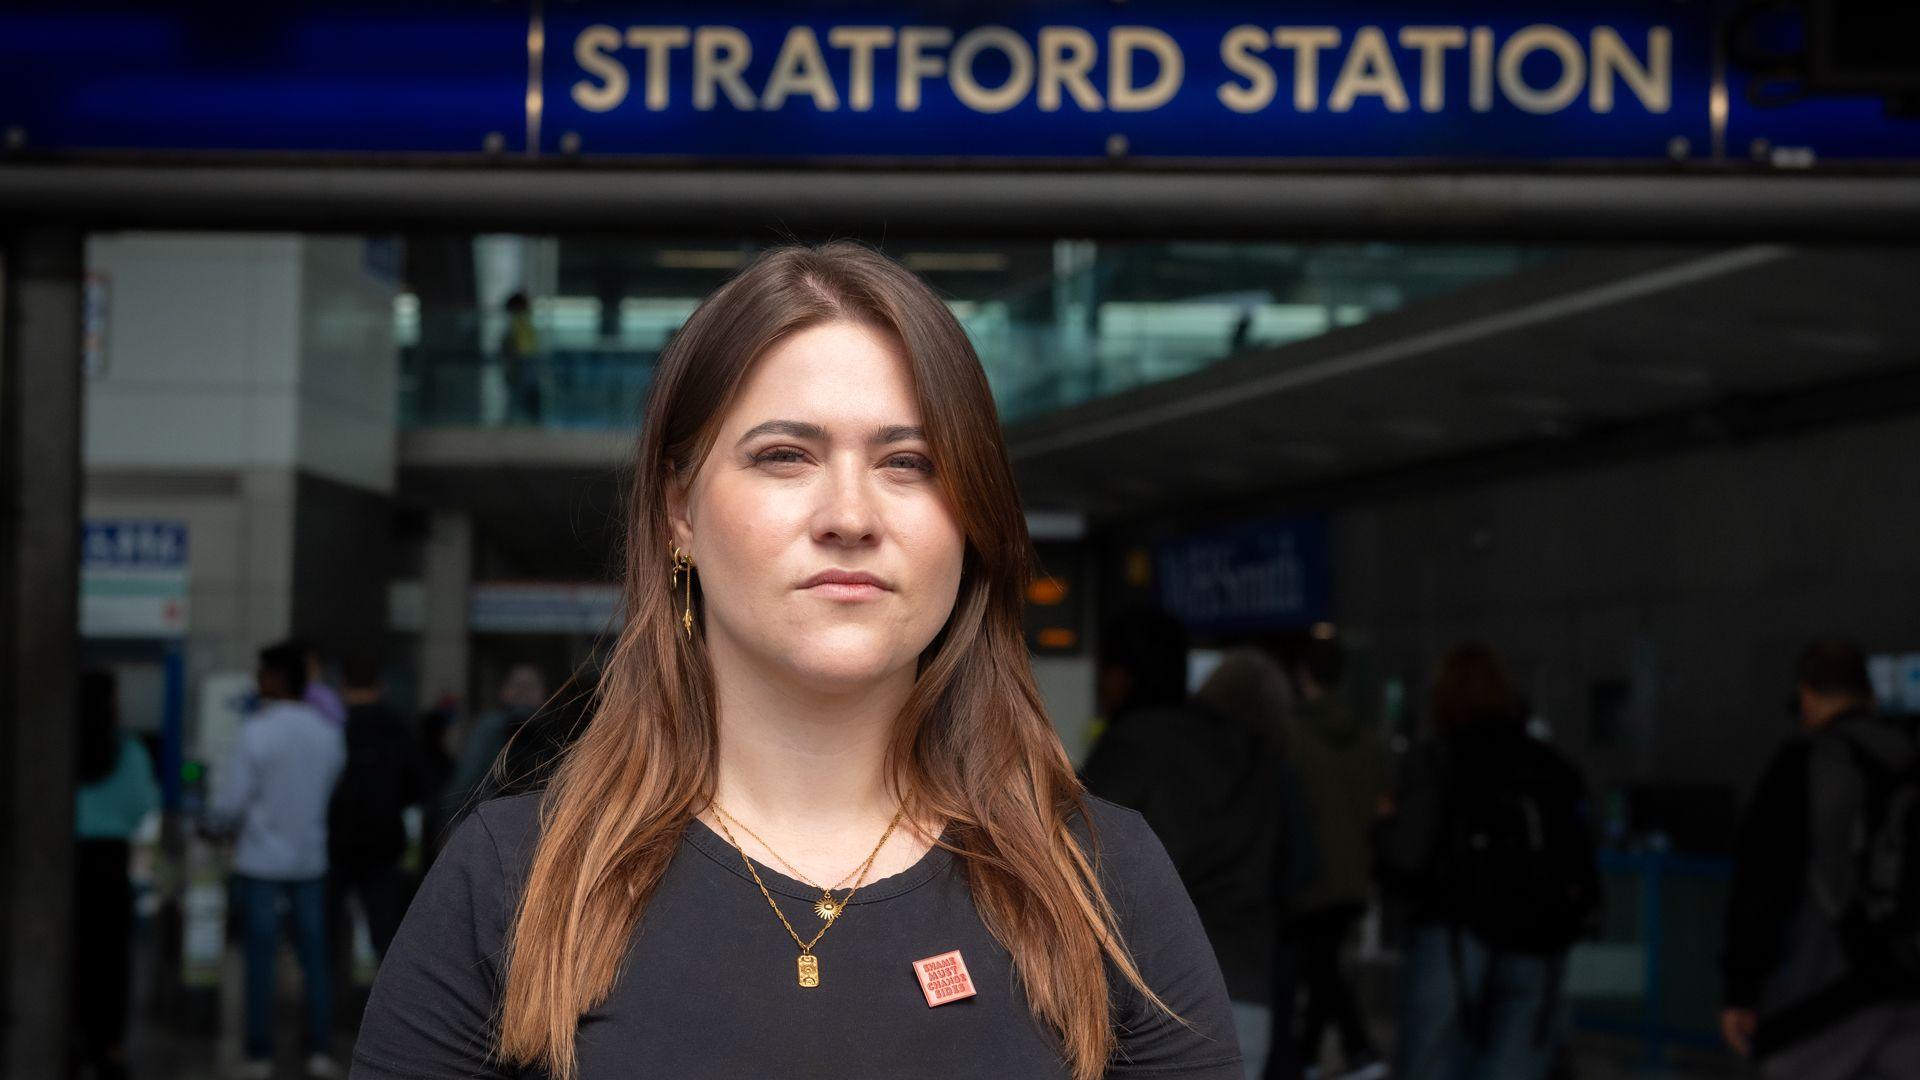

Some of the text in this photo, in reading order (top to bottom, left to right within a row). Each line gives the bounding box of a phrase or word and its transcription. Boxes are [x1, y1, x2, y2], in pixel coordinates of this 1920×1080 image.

[570, 23, 1674, 115] STRATFORD STATION
[928, 966, 958, 981] MUST
